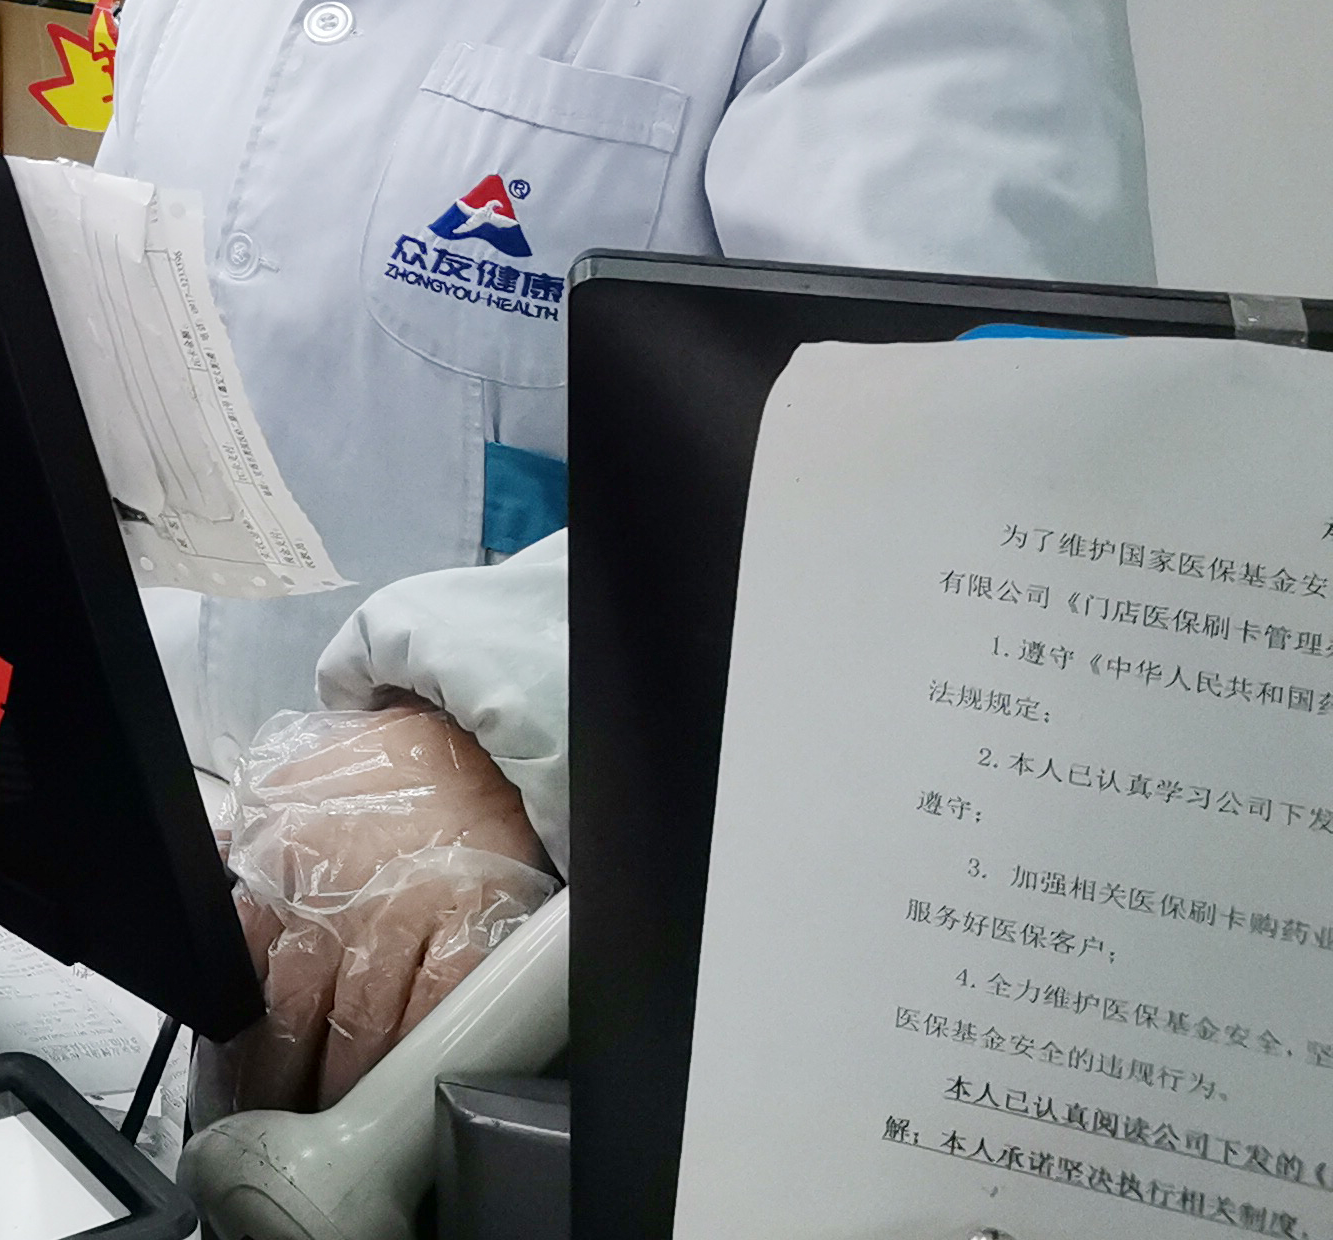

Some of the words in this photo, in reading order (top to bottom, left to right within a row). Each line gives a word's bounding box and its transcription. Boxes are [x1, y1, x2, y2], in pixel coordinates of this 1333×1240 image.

[390, 233, 566, 304] 众友健康
[1000, 523, 1329, 601] 为了维护国家医保基金安
